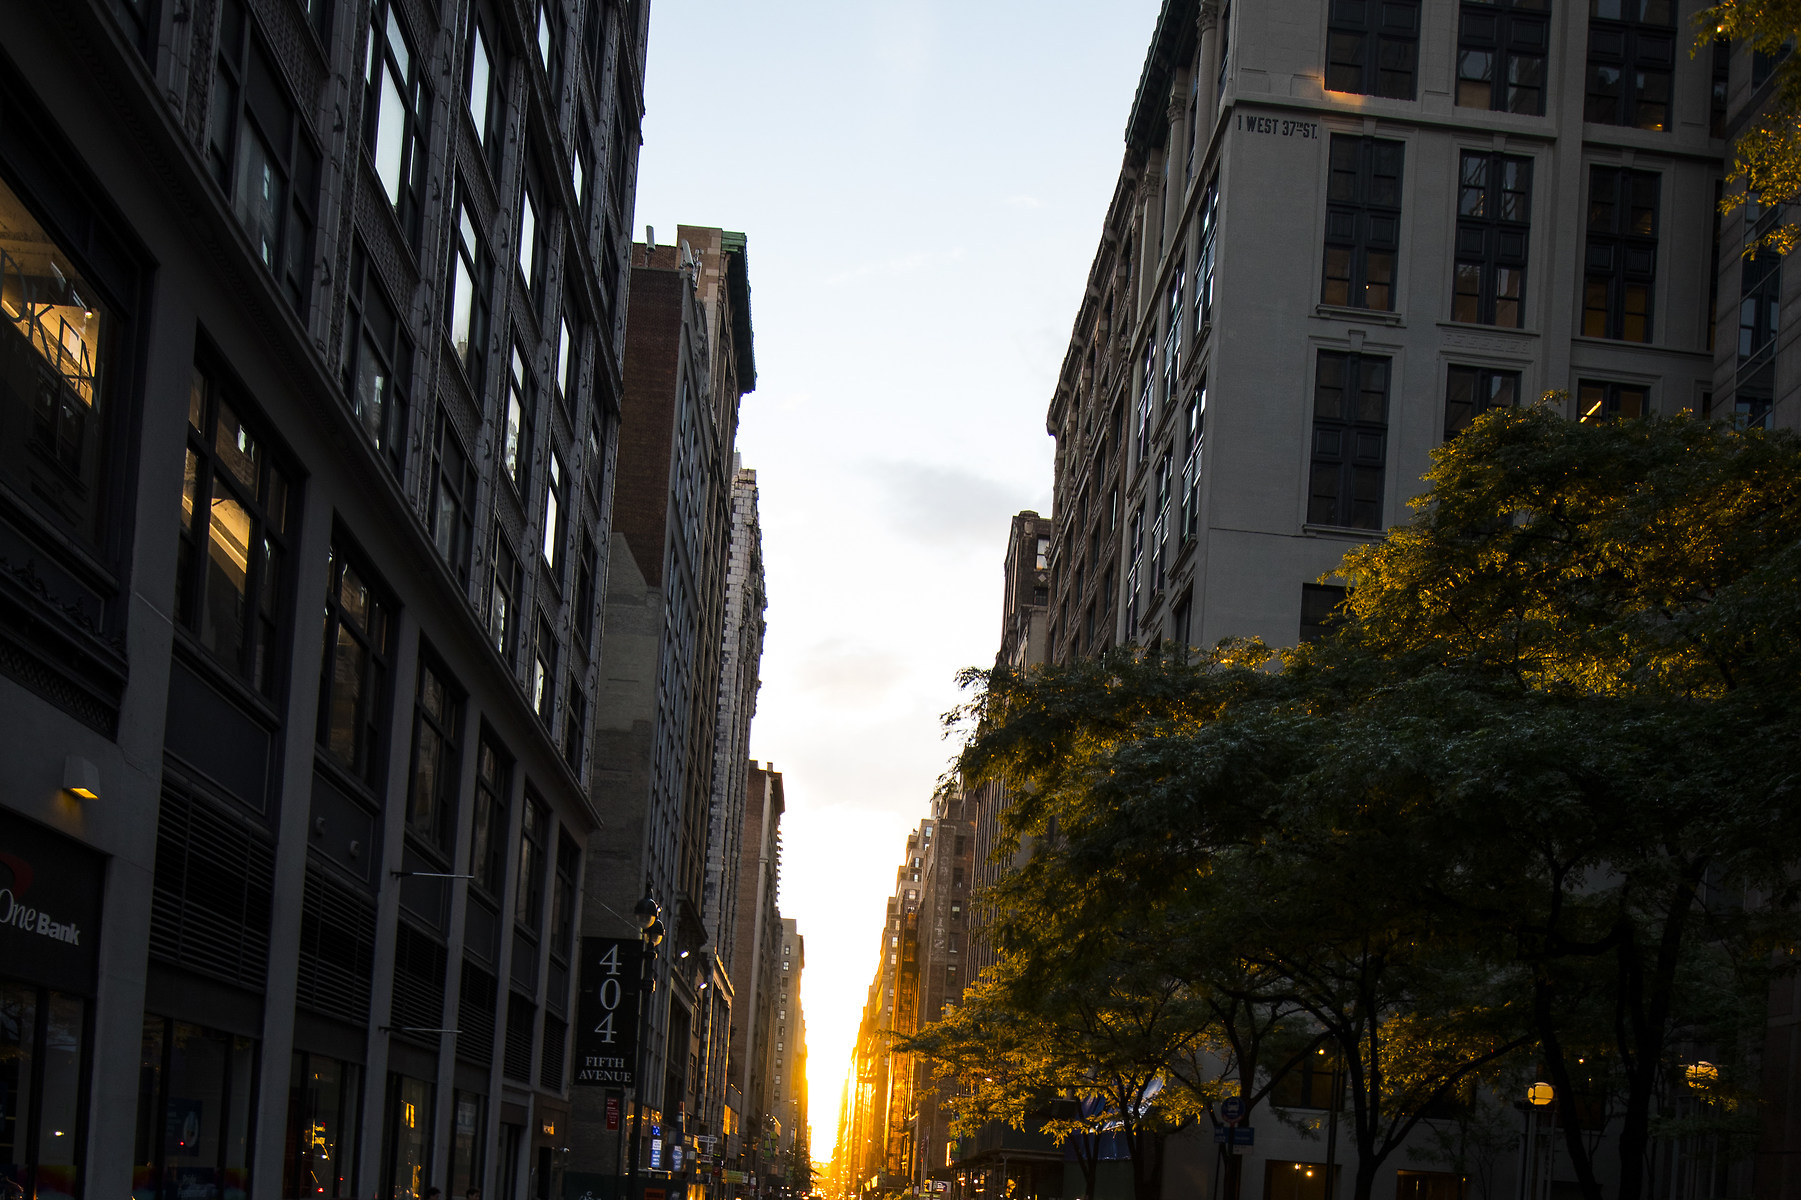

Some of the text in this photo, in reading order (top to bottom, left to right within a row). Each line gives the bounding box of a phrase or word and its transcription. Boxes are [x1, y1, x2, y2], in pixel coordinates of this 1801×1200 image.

[1237, 114, 1243, 131] 1
[1246, 116, 1279, 135] WEST
[36, 911, 81, 946] Bank
[585, 1056, 625, 1069] FIFTH
[578, 1069, 632, 1083] AVENUE
